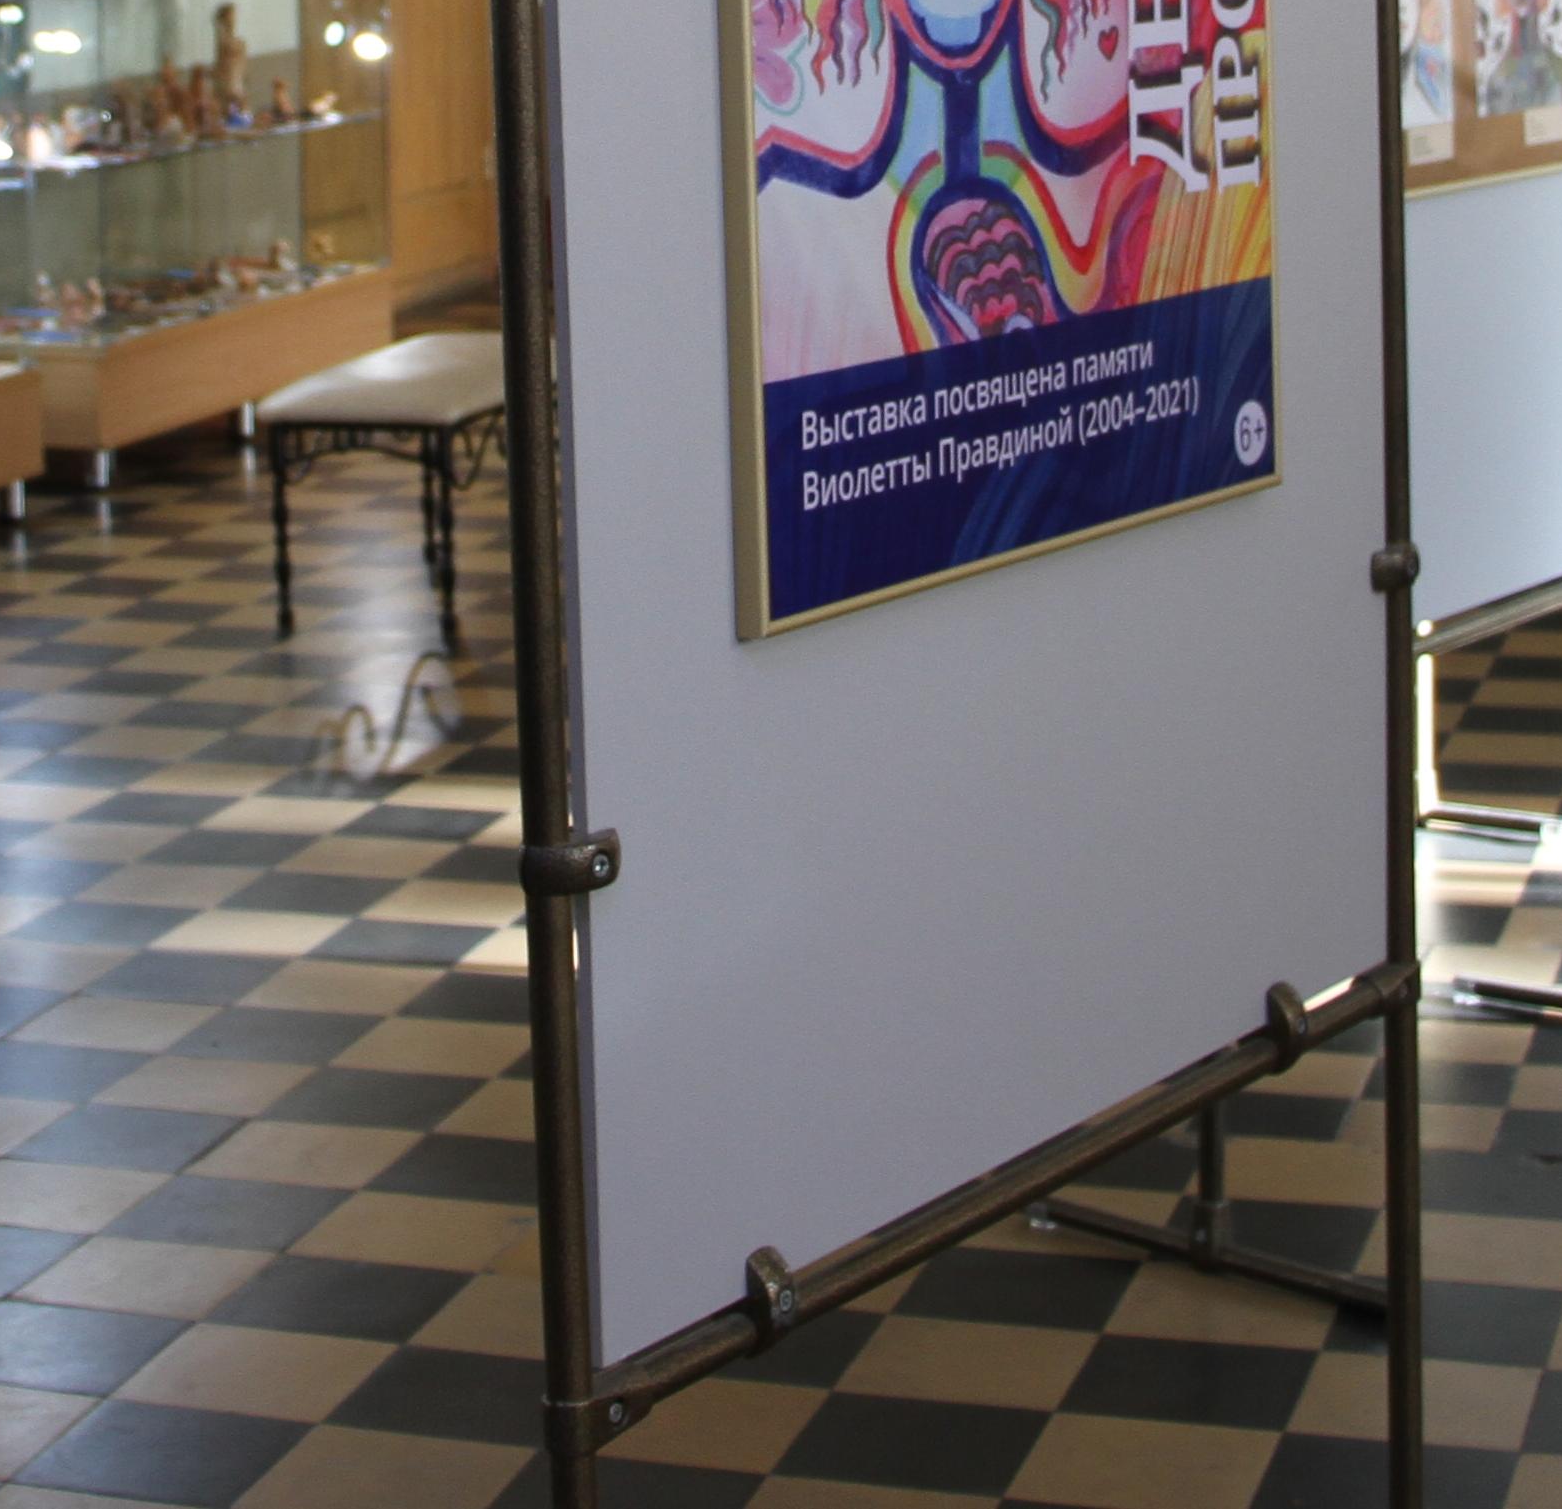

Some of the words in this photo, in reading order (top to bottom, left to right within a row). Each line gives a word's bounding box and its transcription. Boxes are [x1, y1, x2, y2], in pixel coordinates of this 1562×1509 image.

[801, 394, 927, 451] Выставка
[934, 361, 1067, 420] посвящена
[1073, 341, 1153, 386] памяти
[1238, 415, 1265, 452] 6+
[802, 451, 932, 511] Виолетты
[939, 405, 1073, 483] Правдиной
